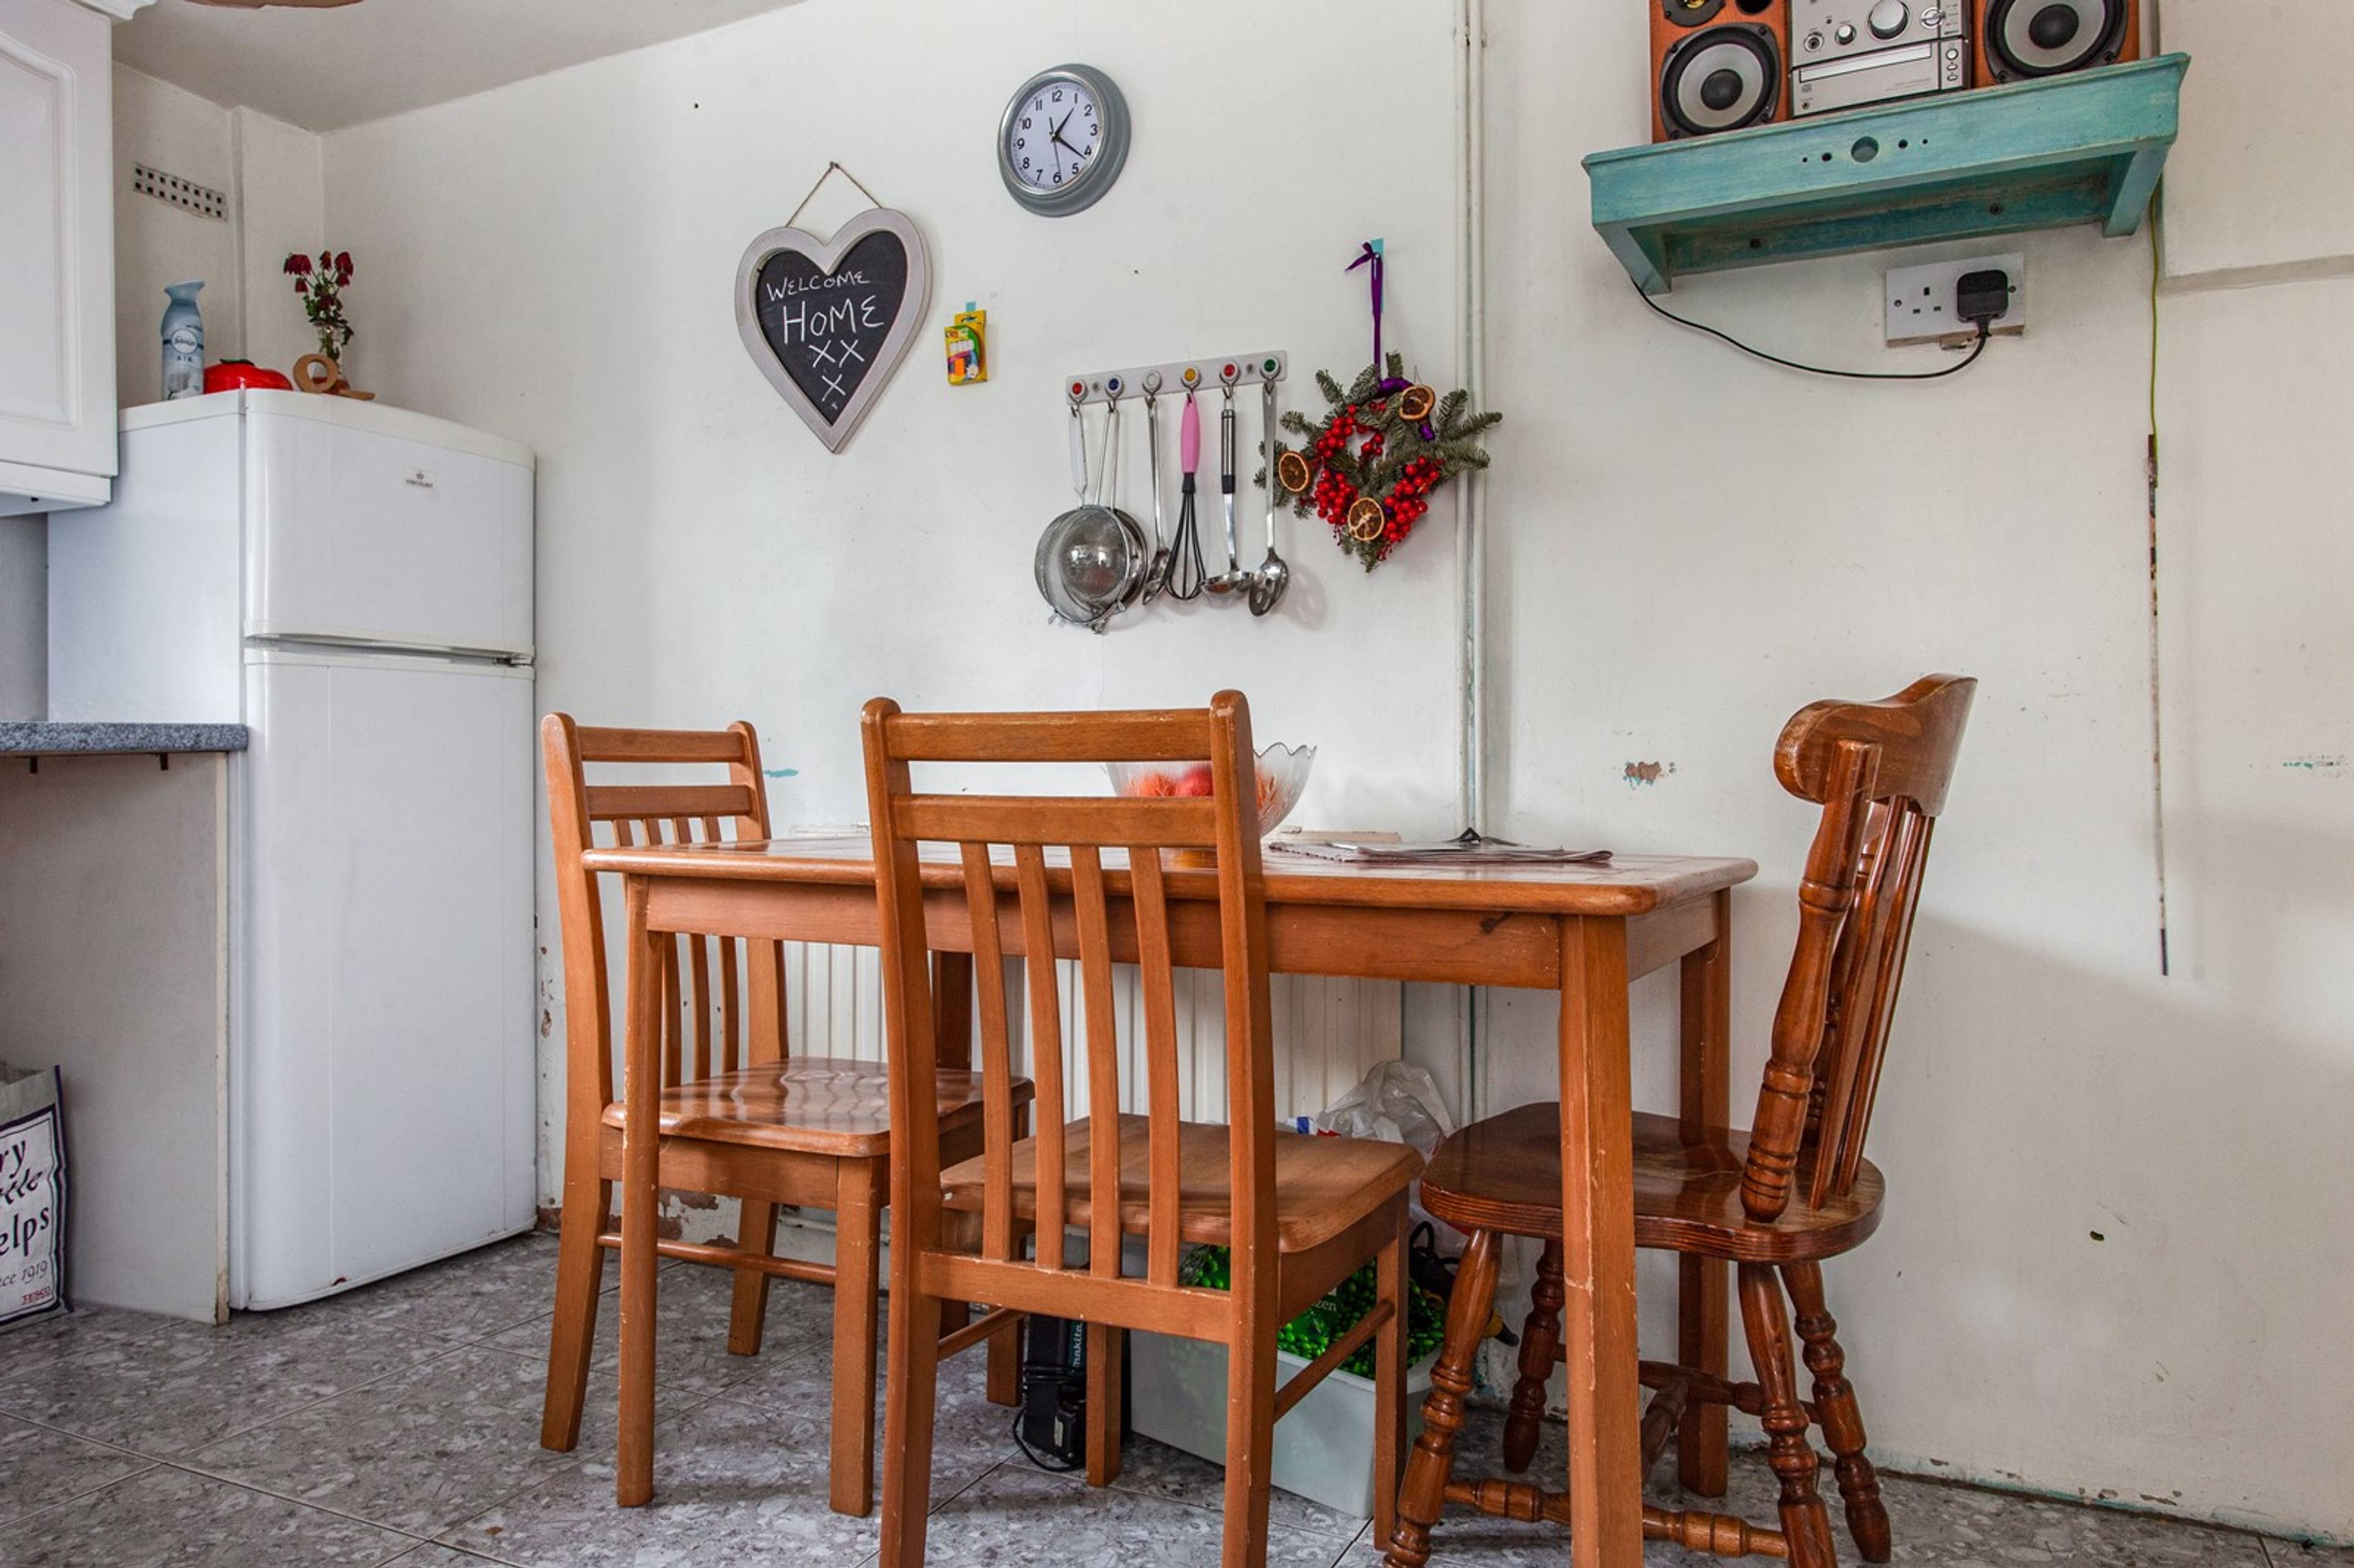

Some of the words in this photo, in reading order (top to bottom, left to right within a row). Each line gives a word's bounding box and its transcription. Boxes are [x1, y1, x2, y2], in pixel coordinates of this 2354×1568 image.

[1051, 90, 1063, 102] 12
[1074, 93, 1078, 104] 1
[1035, 100, 1043, 111] 11
[1084, 104, 1092, 116] 2
[1022, 118, 1032, 130] 10
[1090, 124, 1098, 136] 3
[1016, 138, 1025, 150] 9
[1084, 145, 1092, 156] 4
[1022, 157, 1030, 169] 8
[1072, 163, 1079, 175] 5
[1036, 169, 1043, 181] 7
[1053, 172, 1061, 183] 6
[766, 270, 870, 301] WELCOME
[782, 294, 885, 344] HOME
[21, 1260, 48, 1284] 1919
[1072, 1322, 1083, 1368] makita
